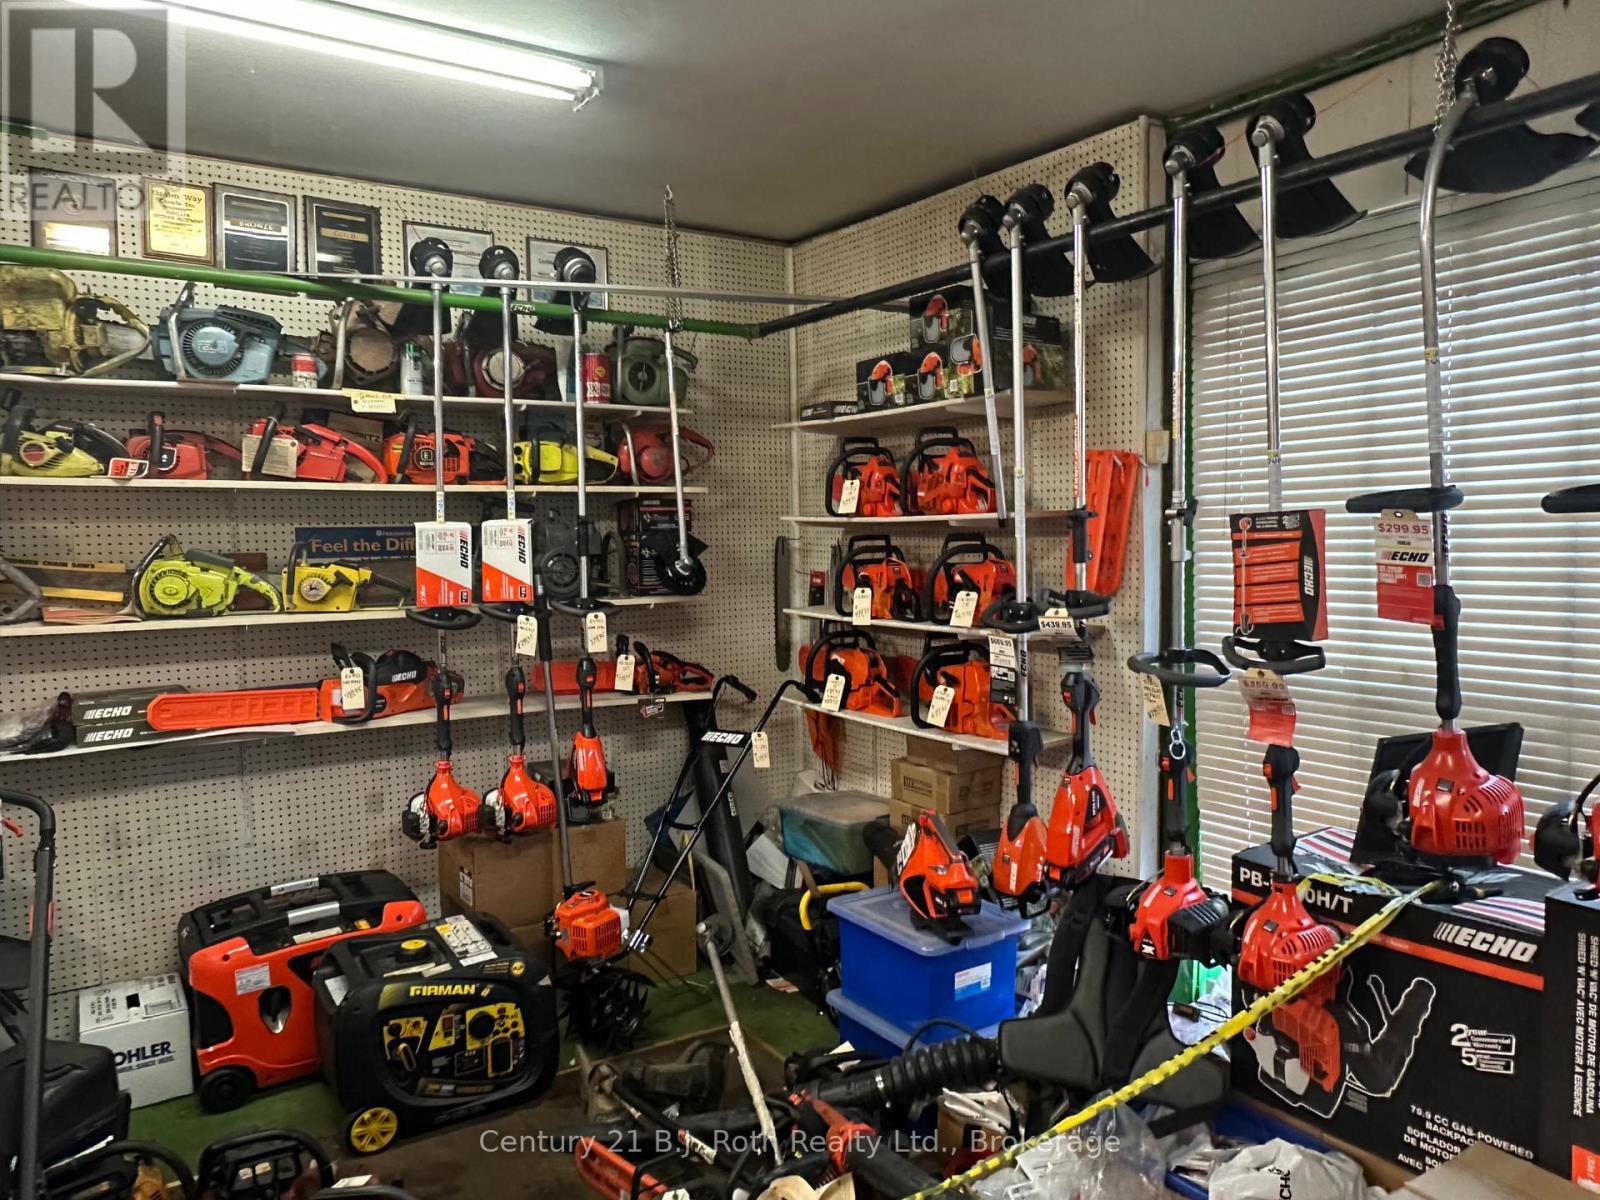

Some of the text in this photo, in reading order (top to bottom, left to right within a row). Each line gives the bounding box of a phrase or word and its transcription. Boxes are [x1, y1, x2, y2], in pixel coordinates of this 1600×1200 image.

[1378, 523, 1429, 535] $299.95
[310, 538, 348, 552] Feel
[352, 538, 381, 551] the
[460, 535, 468, 569] ECHO
[518, 530, 526, 564] ECHO
[1389, 551, 1430, 563] ECHO
[1304, 562, 1315, 597] ECHO
[1040, 621, 1072, 629] $439.95
[397, 670, 417, 681] ECHO
[92, 706, 132, 719] ECHO
[93, 728, 134, 742] ECHO
[708, 732, 744, 745] ECHO
[1450, 927, 1538, 963] ECHO
[410, 984, 476, 997] FIRMAN
[1576, 999, 1585, 1025] AVEC
[1588, 1003, 1597, 1017] DE
[1451, 1023, 1471, 1047] 2
[1588, 1018, 1597, 1052] MOTOR
[1575, 1025, 1584, 1065] MOTEUR
[1461, 1047, 1478, 1067] 5
[1587, 1053, 1596, 1067] DE
[1573, 1074, 1583, 1117] ESSENCE
[1586, 1068, 1595, 1114] GASOLINA
[1433, 1114, 1449, 1126] CC
[1403, 1134, 1417, 1146] DE
